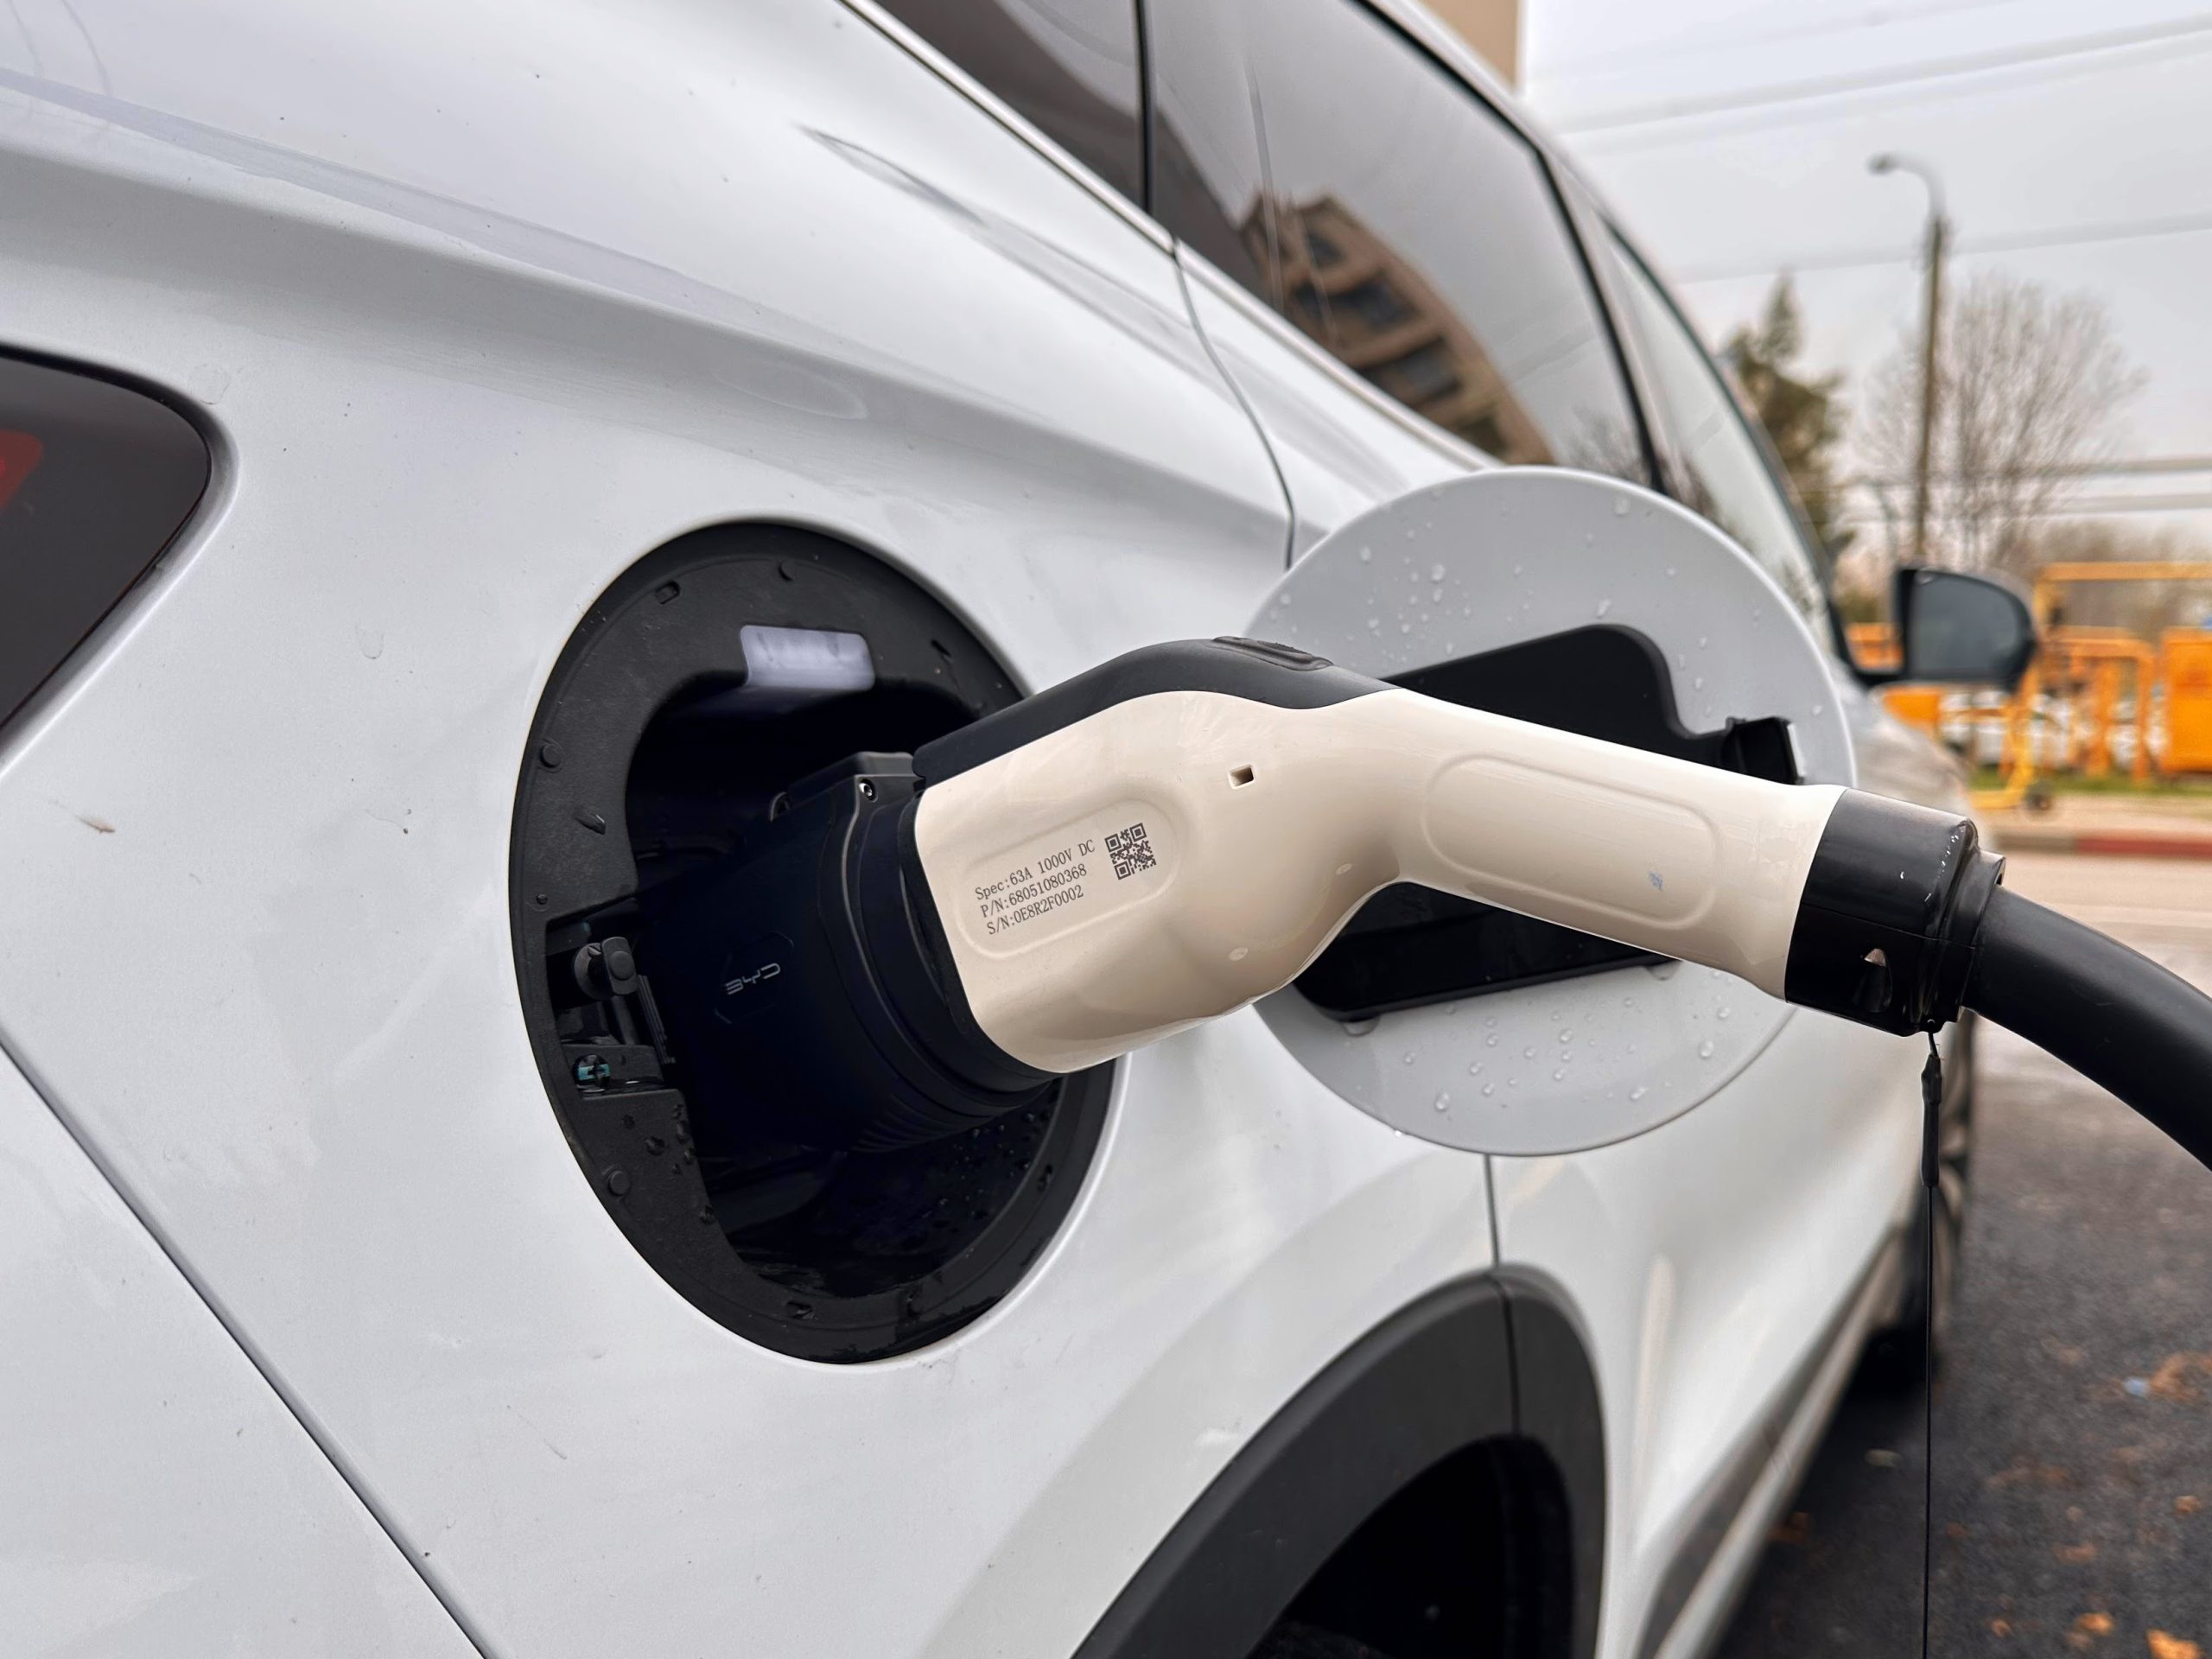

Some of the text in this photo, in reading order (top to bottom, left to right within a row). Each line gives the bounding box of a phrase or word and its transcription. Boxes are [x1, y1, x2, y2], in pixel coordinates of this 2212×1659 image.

[975, 839, 1096, 900] Spec:63A 1000V DC
[980, 863, 1087, 918] P/N:68051080368
[986, 884, 1084, 935] S/N:0E8R2F0002
[724, 963, 781, 995] BYD
